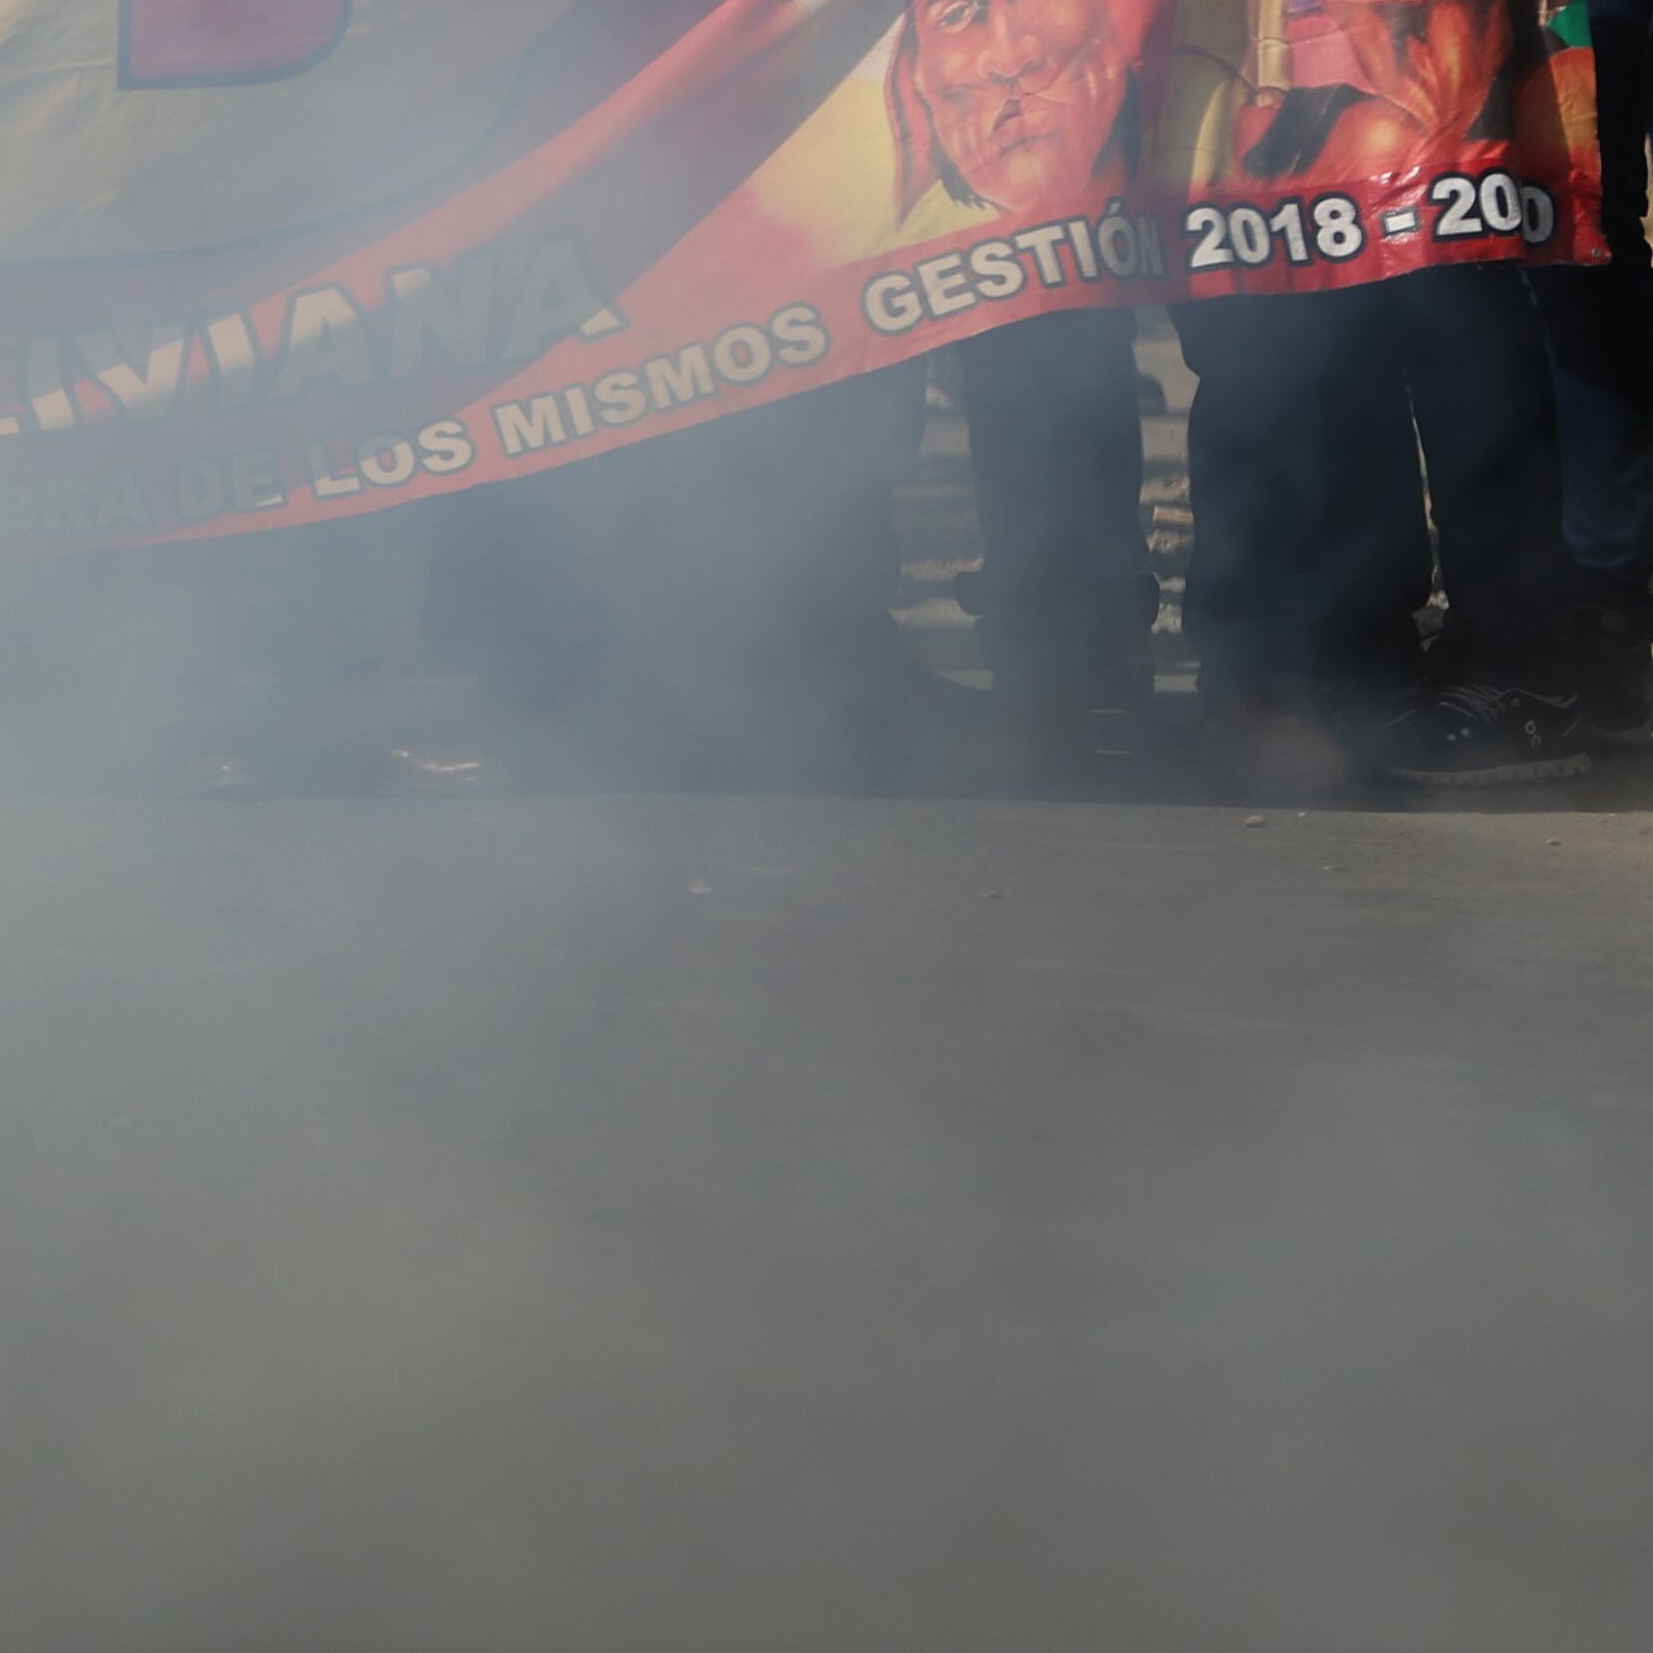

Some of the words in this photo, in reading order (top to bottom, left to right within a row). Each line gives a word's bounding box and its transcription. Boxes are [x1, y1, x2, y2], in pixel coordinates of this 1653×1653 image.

[313, 420, 475, 499] LOS
[495, 304, 829, 456] MISMOS
[864, 199, 1165, 335] GESTIÓN
[1185, 197, 1364, 269] 2018
